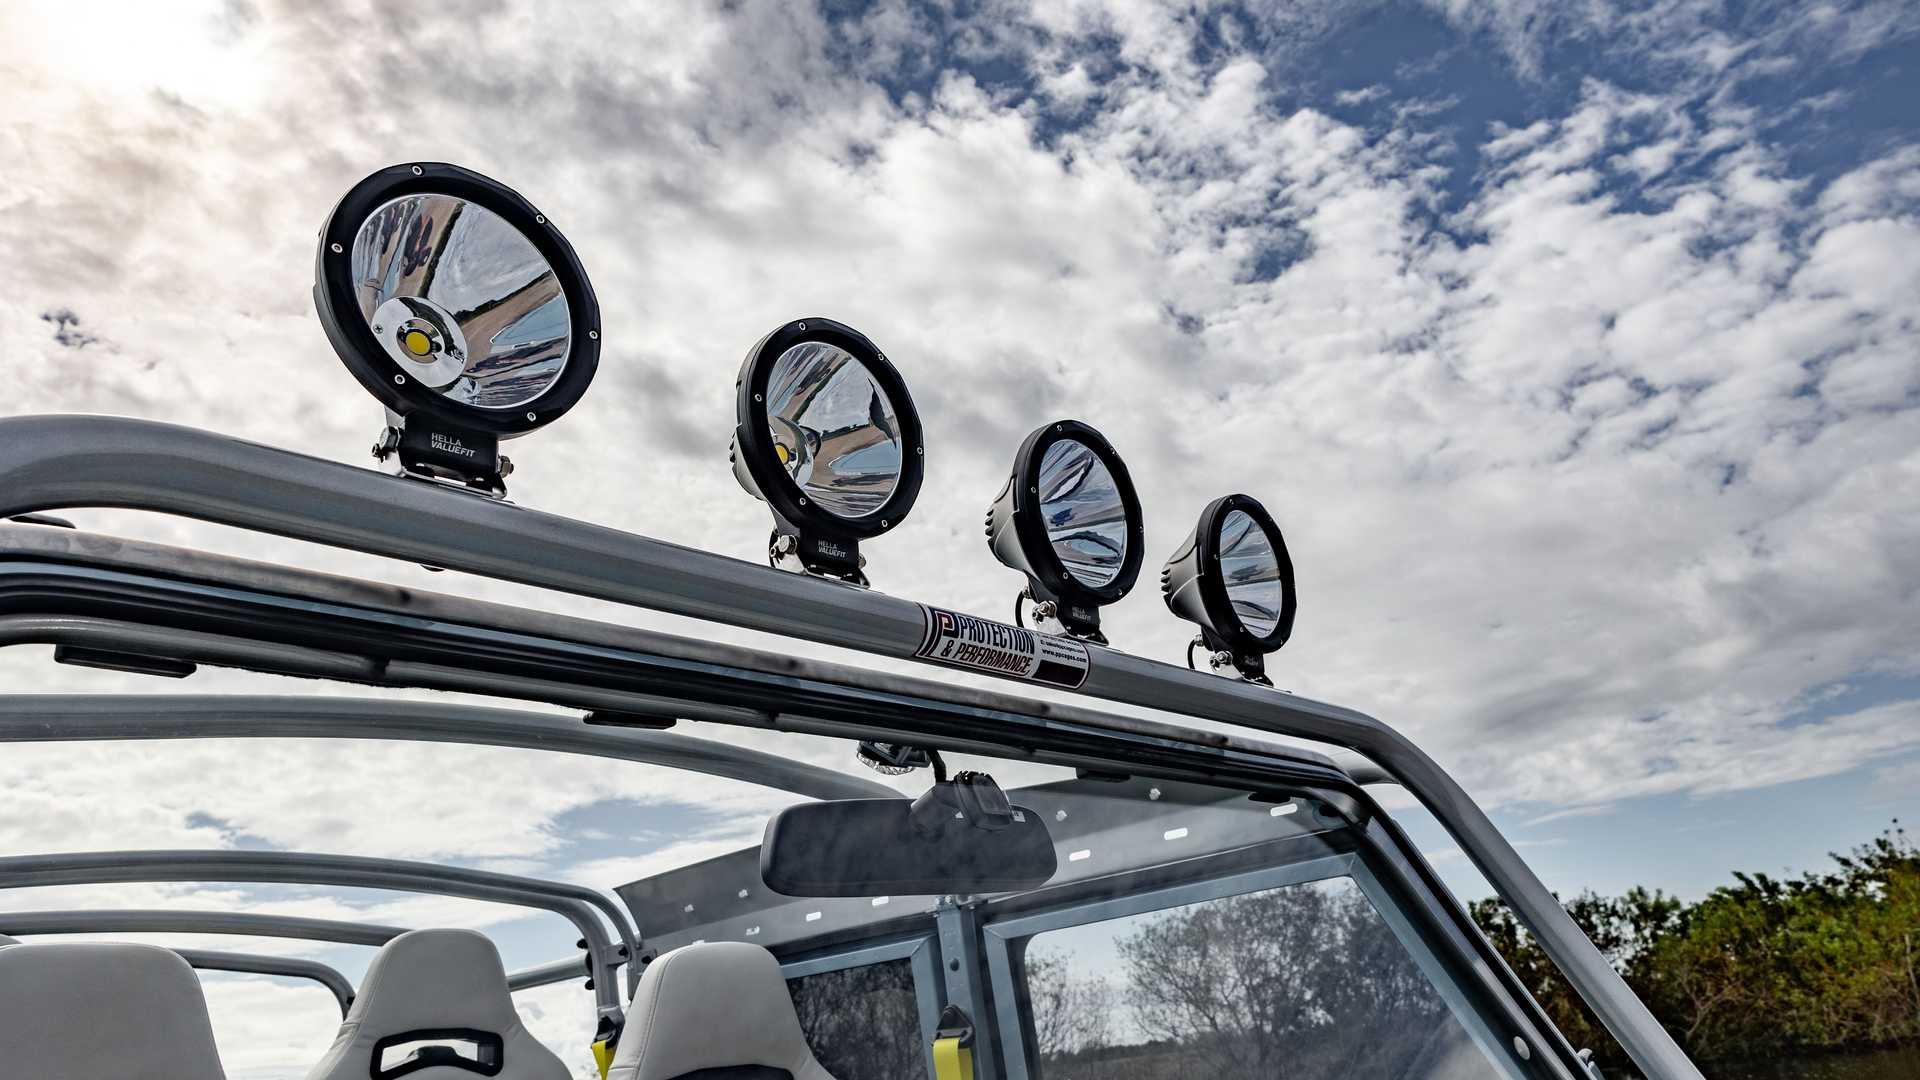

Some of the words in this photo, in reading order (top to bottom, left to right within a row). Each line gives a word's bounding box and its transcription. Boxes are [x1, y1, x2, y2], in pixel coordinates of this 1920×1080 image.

[431, 432, 462, 447] HELLA
[431, 440, 476, 457] VALUEFIT
[818, 546, 847, 558] VALUEFIT
[958, 615, 1035, 655] PROTECTION
[941, 640, 955, 657] &
[952, 643, 1034, 674] PERFORMANCE
